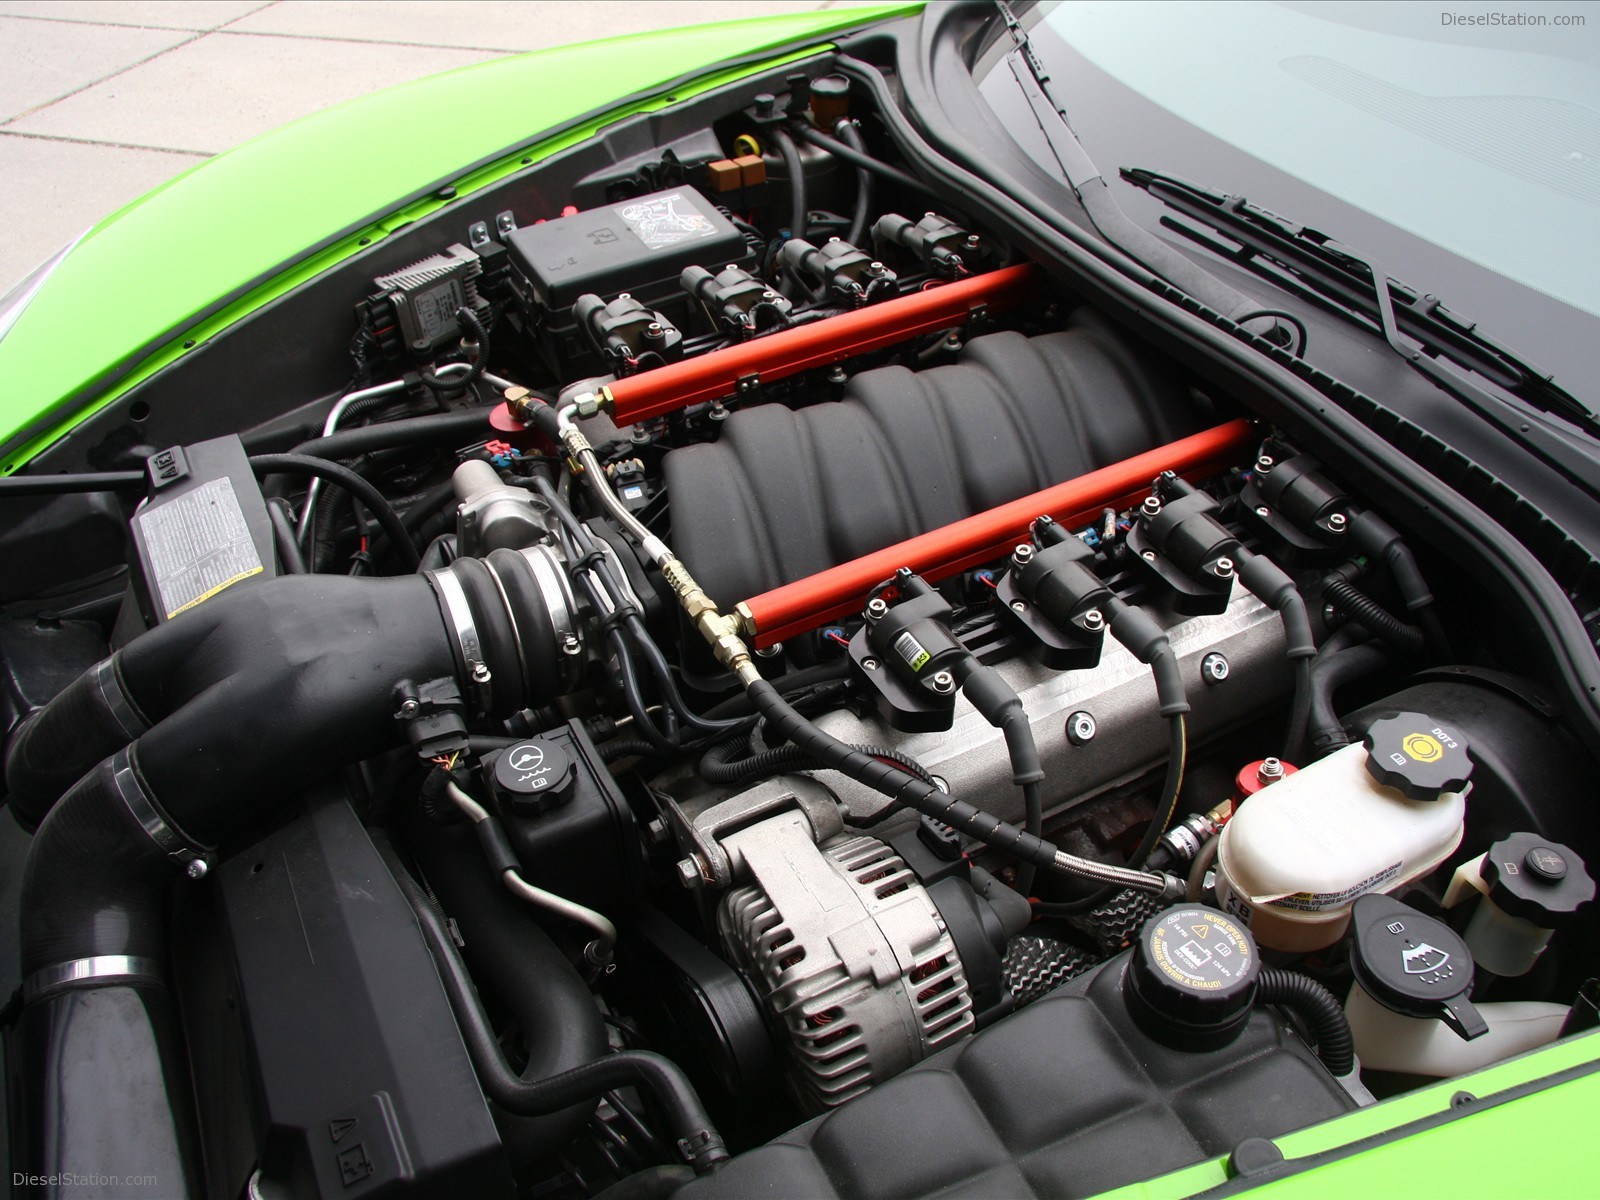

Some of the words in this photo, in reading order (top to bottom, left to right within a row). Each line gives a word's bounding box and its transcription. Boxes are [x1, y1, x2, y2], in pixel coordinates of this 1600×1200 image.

[1431, 727, 1453, 743] DOT
[1447, 741, 1458, 749] 3
[1228, 890, 1237, 908] X
[1240, 903, 1250, 917] B
[1312, 891, 1340, 900] NETTOYER
[1178, 928, 1189, 938] PSI
[1203, 913, 1227, 927] NEVER
[1226, 925, 1242, 940] OPEN
[1238, 939, 1248, 955] HOT!
[1153, 936, 1165, 961] JAMAIS
[1160, 960, 1185, 982] OUVRIR
[1192, 980, 1222, 988] CHAUD!
